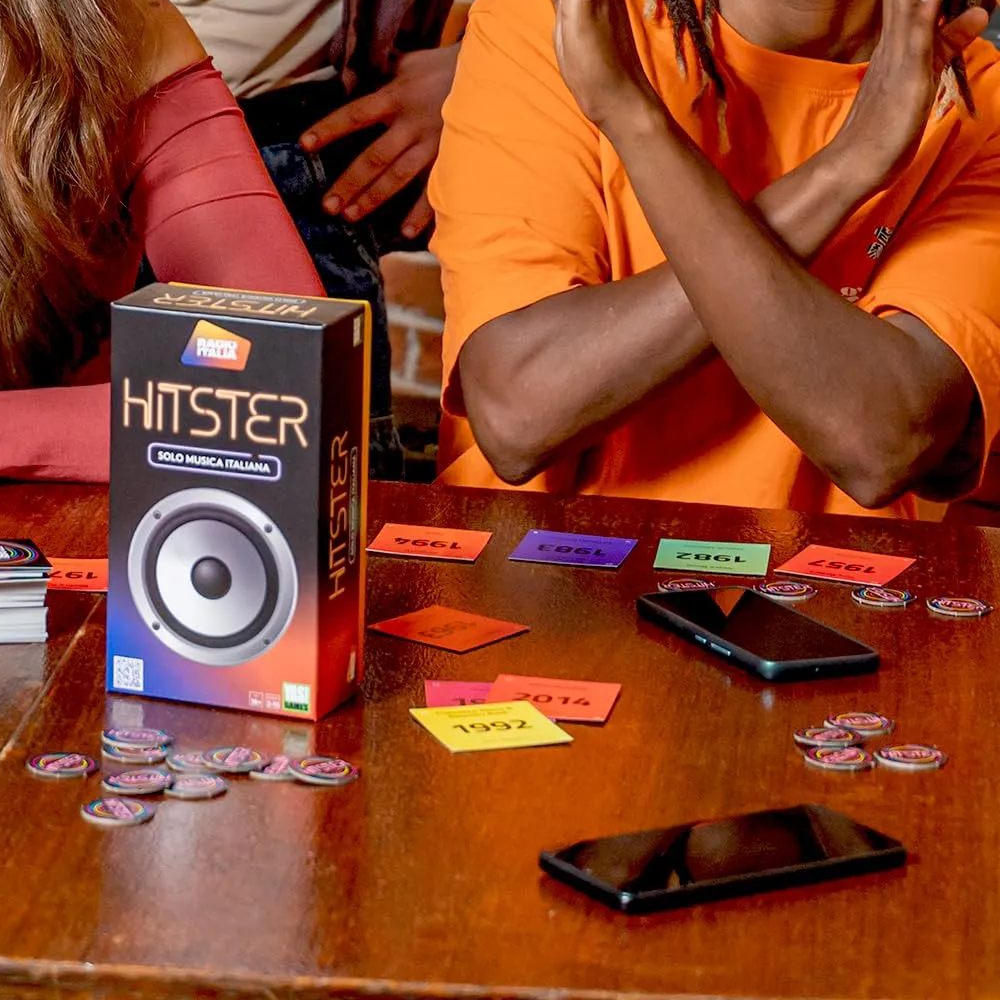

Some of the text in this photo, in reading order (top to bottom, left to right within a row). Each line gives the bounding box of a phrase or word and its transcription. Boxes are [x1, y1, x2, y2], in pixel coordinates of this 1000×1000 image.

[153, 292, 318, 318] HITSTER
[196, 337, 237, 350] RADIO
[196, 347, 238, 360] ITALIA
[123, 377, 308, 448] HITSTER
[157, 450, 271, 474] SOLO MUSICA ITALIANA
[328, 430, 349, 600] HITSTER
[394, 537, 462, 550] 1994
[537, 543, 606, 556] 1983
[675, 551, 747, 563] 1982
[808, 559, 877, 574] 1957
[48, 570, 98, 580] 197
[512, 691, 591, 707] 2014
[453, 719, 534, 734] 1992
